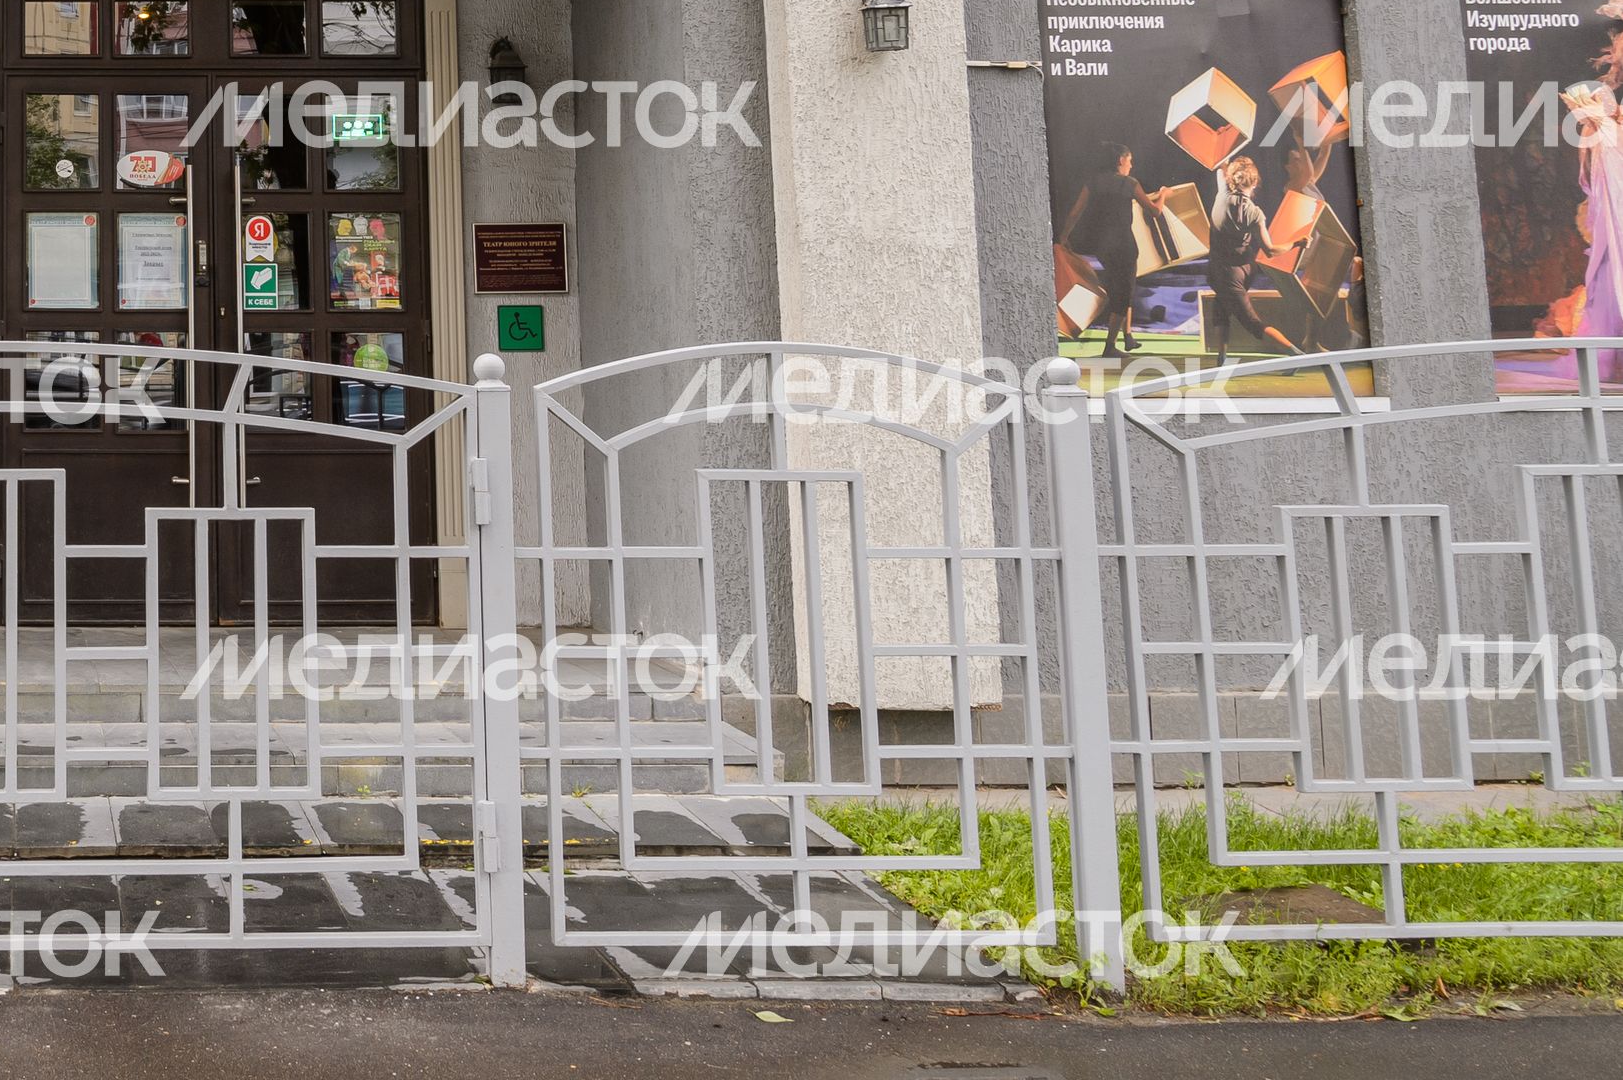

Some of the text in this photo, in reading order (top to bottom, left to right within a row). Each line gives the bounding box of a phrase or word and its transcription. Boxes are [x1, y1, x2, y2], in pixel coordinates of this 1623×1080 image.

[1047, 15, 1165, 33] приключения
[1466, 10, 1580, 31] Изумрудного
[1049, 35, 1113, 56] Карика
[1469, 37, 1531, 54] города
[1051, 58, 1109, 76] и Вали
[254, 298, 274, 306] СЕБЕ
